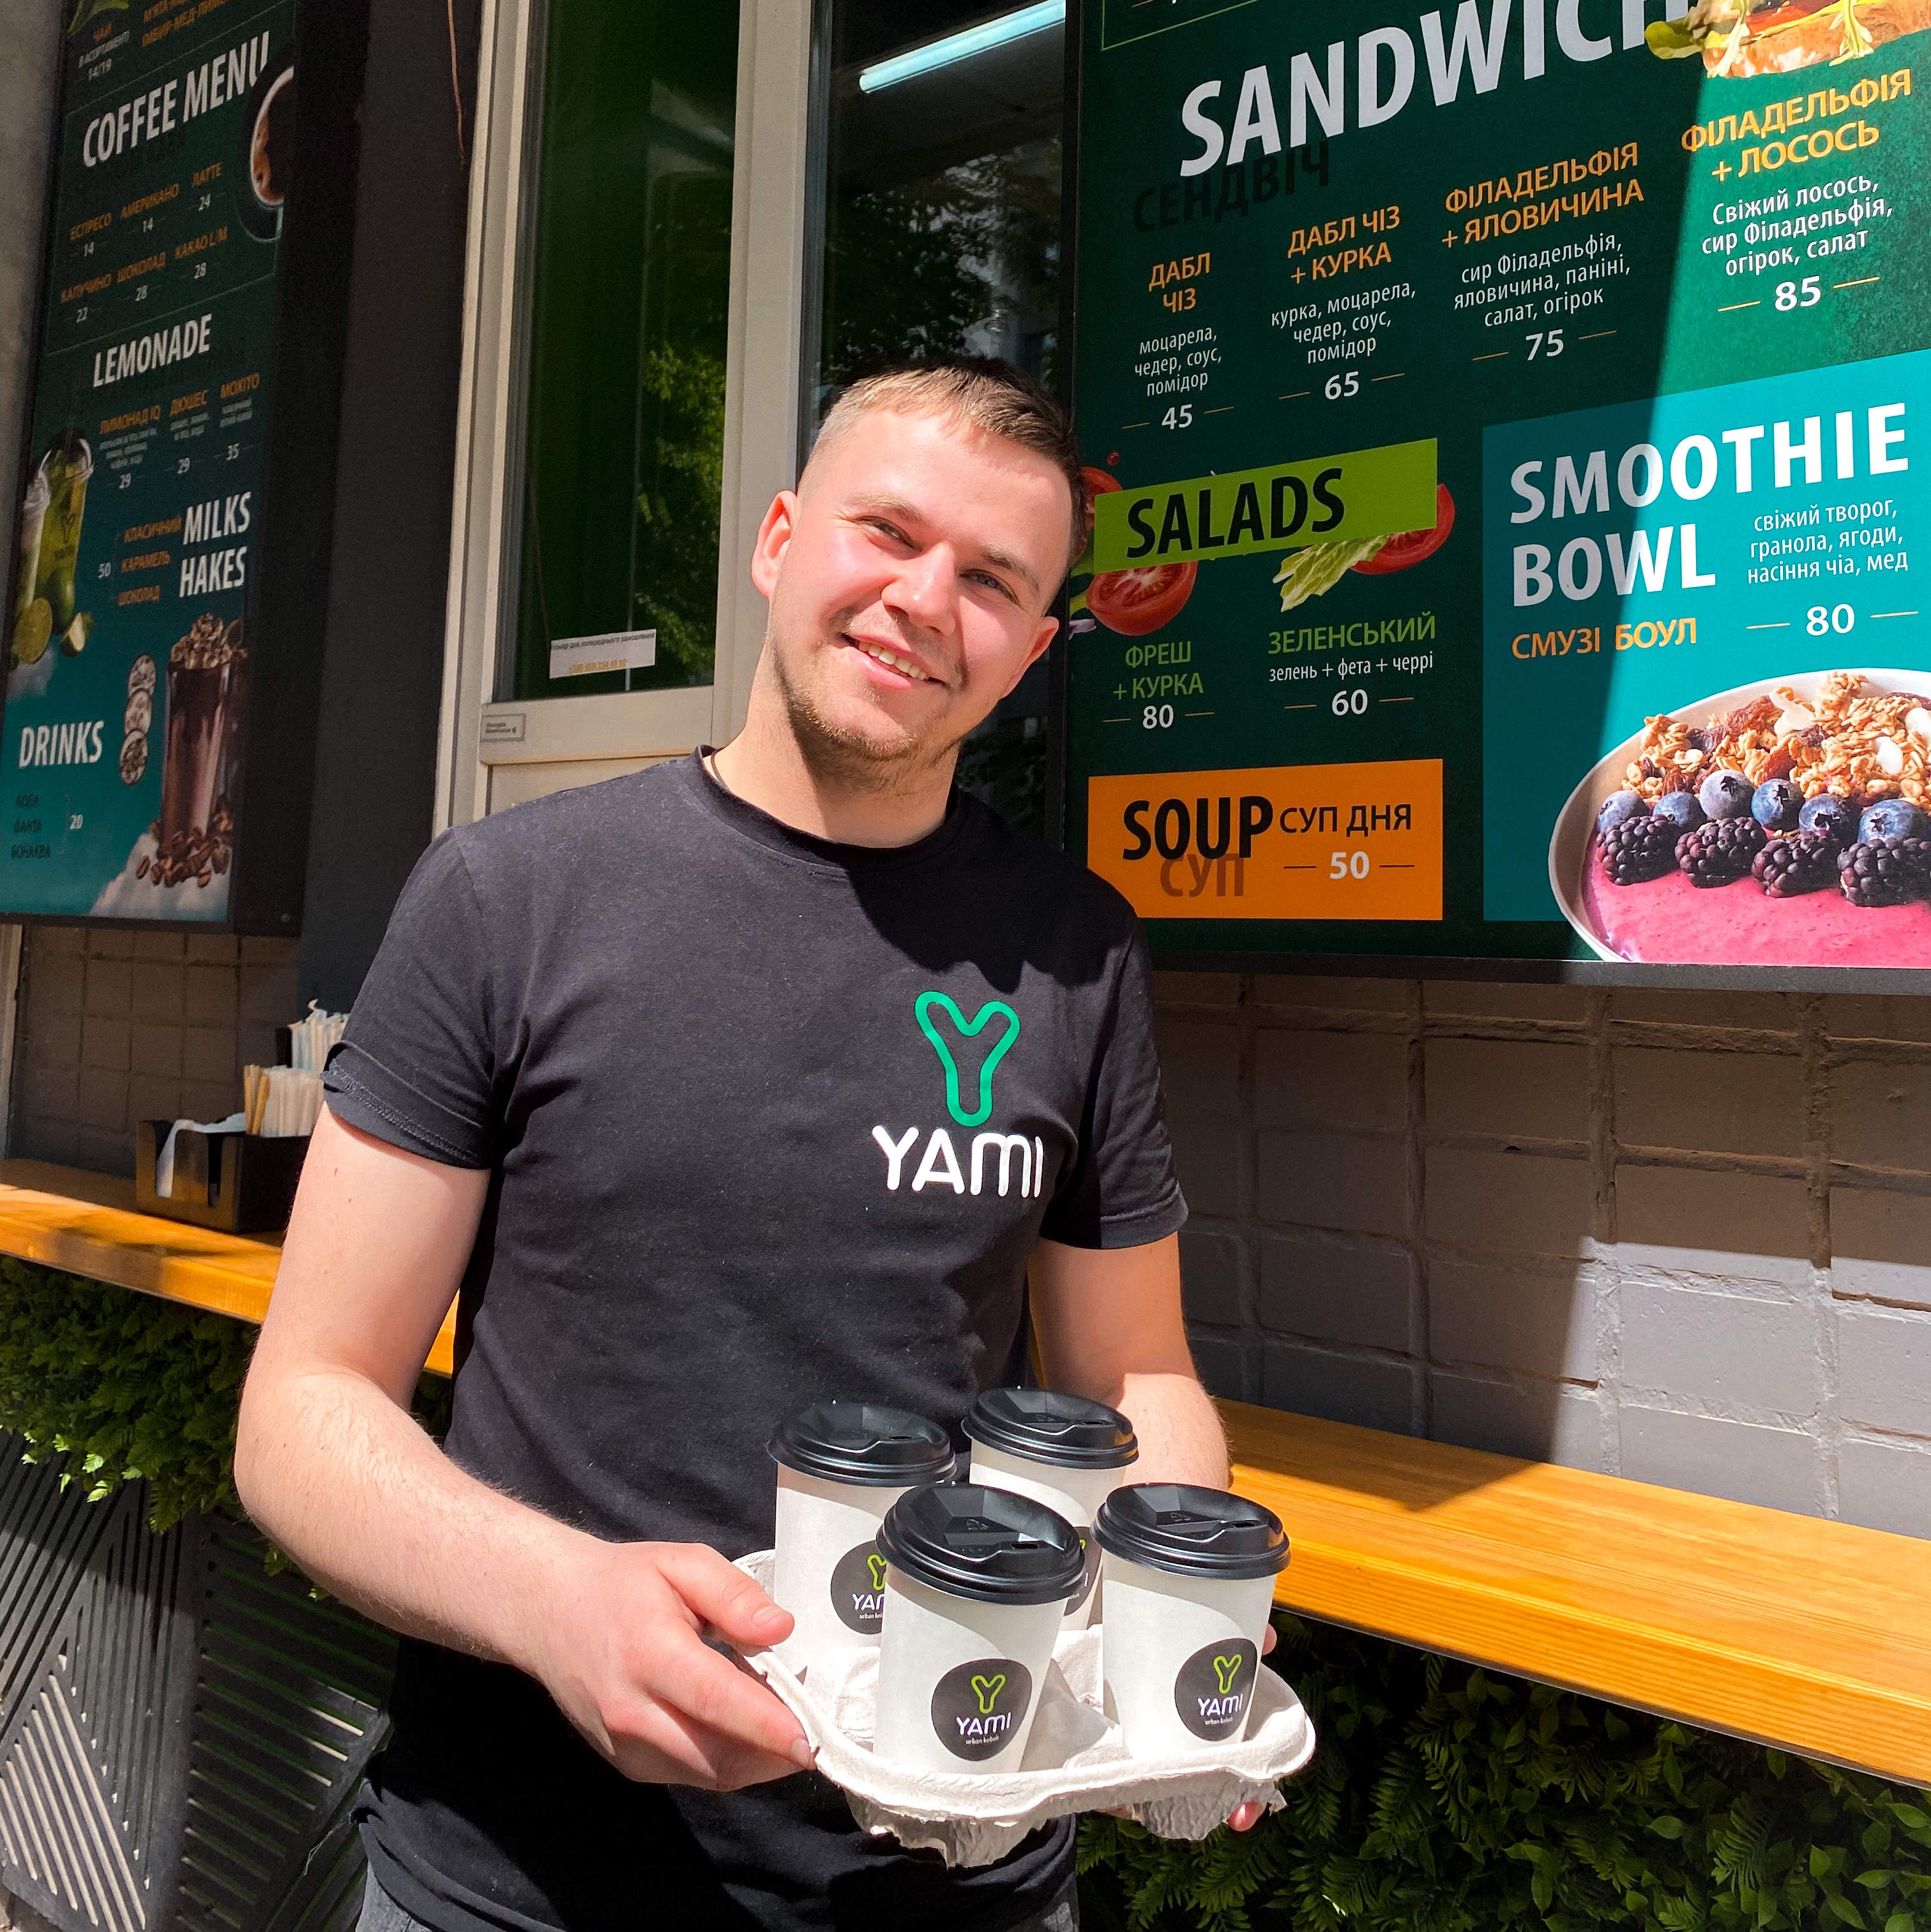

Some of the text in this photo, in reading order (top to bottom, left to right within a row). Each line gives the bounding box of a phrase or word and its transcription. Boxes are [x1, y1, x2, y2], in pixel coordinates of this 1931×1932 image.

[82, 31, 270, 167] COFFEE MENU
[1681, 68, 1911, 153] ФІЛАДЕЛЬФІЯ
[1712, 119, 1880, 182] + ЛОСОСЬ
[1133, 140, 1329, 233] СЕНДВІЧ
[1445, 142, 1639, 215] ФІЛАДЕЛЬФІЯ
[70, 162, 223, 240] ЕСПРЕСО АМЕРИКАНО ЛАТТЕ
[1441, 178, 1644, 248] + ЯЛОВИЧИНА
[1713, 175, 1879, 226] Свіжий лосось,
[84, 193, 211, 257] 14 14 24
[1288, 205, 1400, 257] ДАБЛ ЧІЗ
[1702, 195, 1893, 255] сир Філадельфія,
[61, 273, 112, 303] КАПУЧИНО
[117, 252, 166, 283] ШОКОЛАД
[175, 232, 208, 259] КАКАО
[1149, 252, 1211, 291] ДАБЛ
[1291, 242, 1392, 284] + КУРКА
[1461, 231, 1622, 285] сир Філадельфія,
[1725, 229, 1868, 277] огірок, салат
[77, 262, 208, 323] 22 28 28
[1163, 287, 1197, 313] ЧІЗ
[1453, 254, 1631, 310] яловичина, паніні,
[1775, 275, 1822, 312] 85
[1271, 282, 1416, 330] курка, моцарела,
[1484, 287, 1604, 328] салат, огірок
[1140, 326, 1218, 355] моцарела,
[1294, 311, 1392, 345] чедер, соус,
[1525, 329, 1564, 363] 75
[93, 313, 213, 387] LEMONADE
[1135, 347, 1222, 377] чедер, соус,
[1308, 336, 1377, 363] помідор
[1147, 371, 1208, 397] помідор
[1324, 371, 1359, 400] 65
[100, 412, 149, 434] ЛИМОНАД
[170, 390, 208, 416] ДЮШЕС
[1161, 404, 1193, 430] 45
[226, 443, 239, 460] 35
[1510, 402, 1909, 524] SMOOTHIE
[183, 491, 252, 545] MILKS
[1126, 468, 1345, 559] SALADS
[1753, 498, 1898, 532] свіжий творог,
[121, 551, 170, 573] КАРАМЕЛЬ
[1750, 526, 1904, 559] гранола, ягоди,
[98, 563, 112, 579] 50
[179, 546, 248, 598] HAKES
[1513, 524, 1716, 607] BOWL
[1748, 552, 1909, 584] насіння чіа, мед
[1268, 611, 1435, 655] ЗЕЛЕНСЬКИЙ
[1511, 618, 1697, 659] СМУЗІ БОУЛ
[1806, 604, 1855, 637] 80
[1125, 641, 1192, 668] ФРЕШ
[1269, 651, 1433, 681] зелень + фета + черрі
[1113, 672, 1204, 700] + КУРКА
[1331, 688, 1368, 716] 60
[1142, 704, 1174, 729] 80
[19, 720, 104, 768] DRINKS
[70, 814, 83, 830] 20
[1123, 796, 1273, 860] SOUP
[1280, 803, 1411, 837] СУП ДНЯ
[1160, 853, 1245, 897] СУП
[1329, 851, 1370, 879] 50
[872, 1125, 1043, 1198] YAMI
[852, 1593, 884, 1610] YA
[956, 1712, 1011, 1735] YAMI
[1197, 1692, 1243, 1716] YAMI
